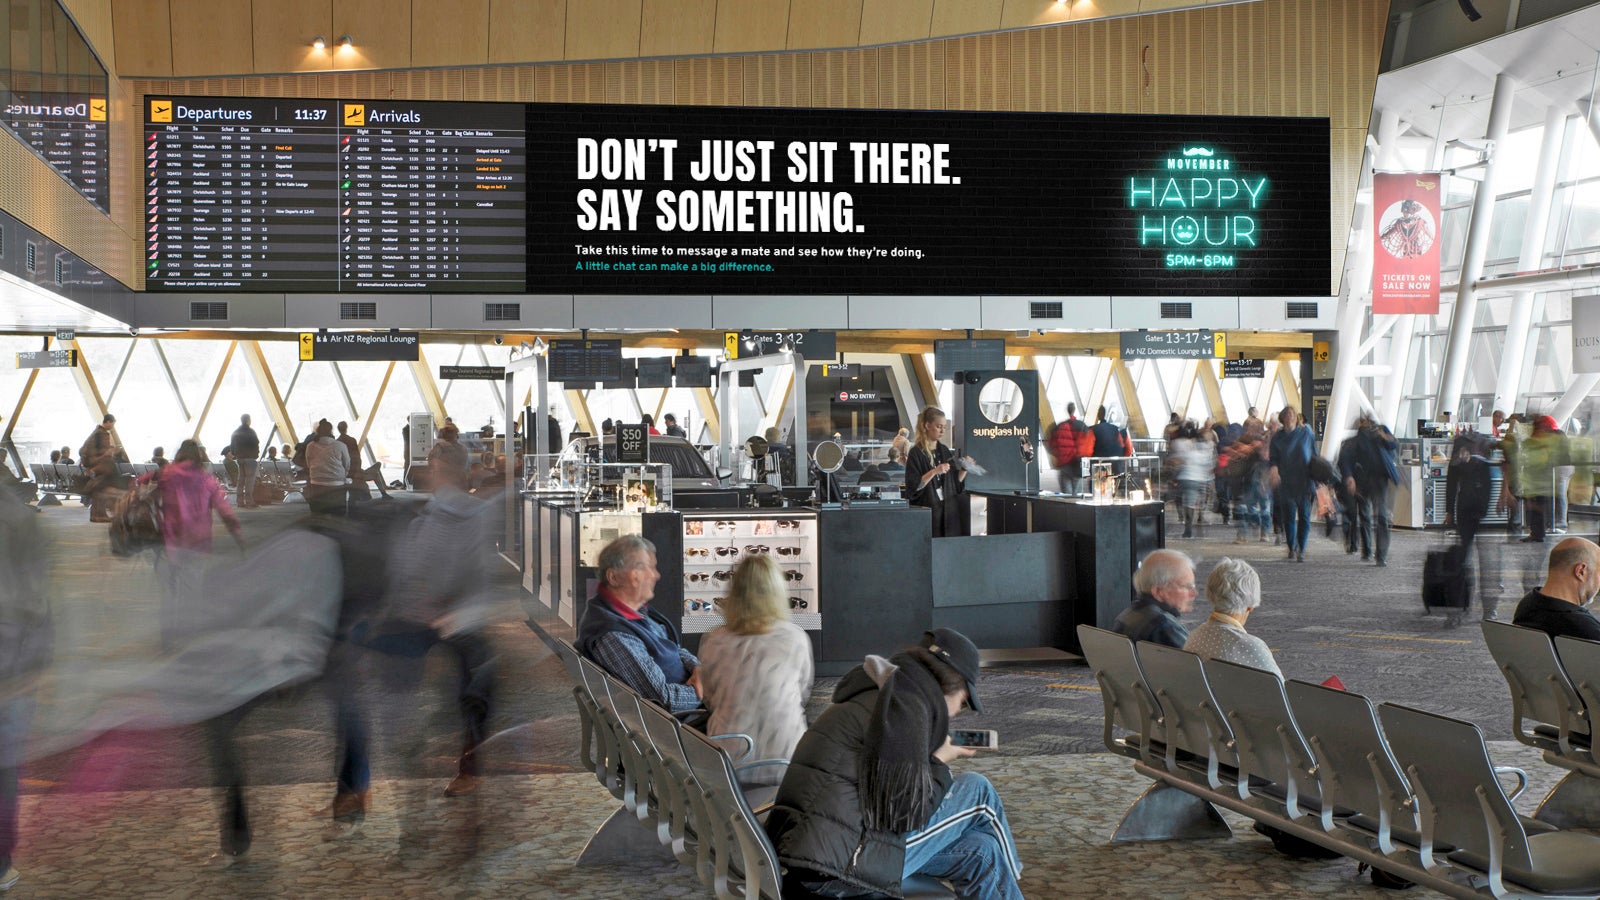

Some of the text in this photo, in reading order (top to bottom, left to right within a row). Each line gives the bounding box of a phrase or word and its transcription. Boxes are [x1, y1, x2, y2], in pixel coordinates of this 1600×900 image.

[177, 105, 252, 121] Departures
[294, 110, 327, 120] 11:37
[369, 110, 421, 123] Arrivals
[690, 140, 774, 183] JUST
[787, 141, 837, 183] SIT
[850, 143, 961, 185] THERE.
[1167, 159, 1230, 170] MOVEMBER
[1131, 177, 1266, 208] HAPPY
[576, 189, 865, 233] SAY SOMETHING.
[1142, 215, 1255, 246] HOUR
[575, 245, 603, 255] Take
[606, 245, 628, 255] this
[631, 245, 658, 256] time
[661, 246, 674, 256] to
[677, 248, 729, 259] message
[731, 248, 739, 256] a
[741, 246, 770, 256] mate
[774, 246, 795, 257] and
[798, 248, 818, 257] see
[821, 245, 844, 257] how
[891, 246, 925, 259] doing.
[1166, 255, 1233, 266] 5PM-6PM
[576, 261, 583, 271] A
[585, 261, 610, 271] little
[613, 261, 635, 271] chat
[639, 263, 657, 271] can
[660, 262, 688, 271] make
[701, 261, 716, 273] big
[719, 261, 774, 272] difference.
[1382, 282, 1405, 290] SALE
[331, 335, 342, 343] Air
[357, 335, 388, 344] Regional
[390, 335, 416, 345] Lounge
[1166, 333, 1199, 343] 13-17
[1148, 347, 1176, 355] Domestic
[1177, 348, 1199, 356] Lounge
[623, 429, 641, 441] $50
[973, 426, 1029, 439] sunglass hut
[623, 441, 640, 450] OFF
